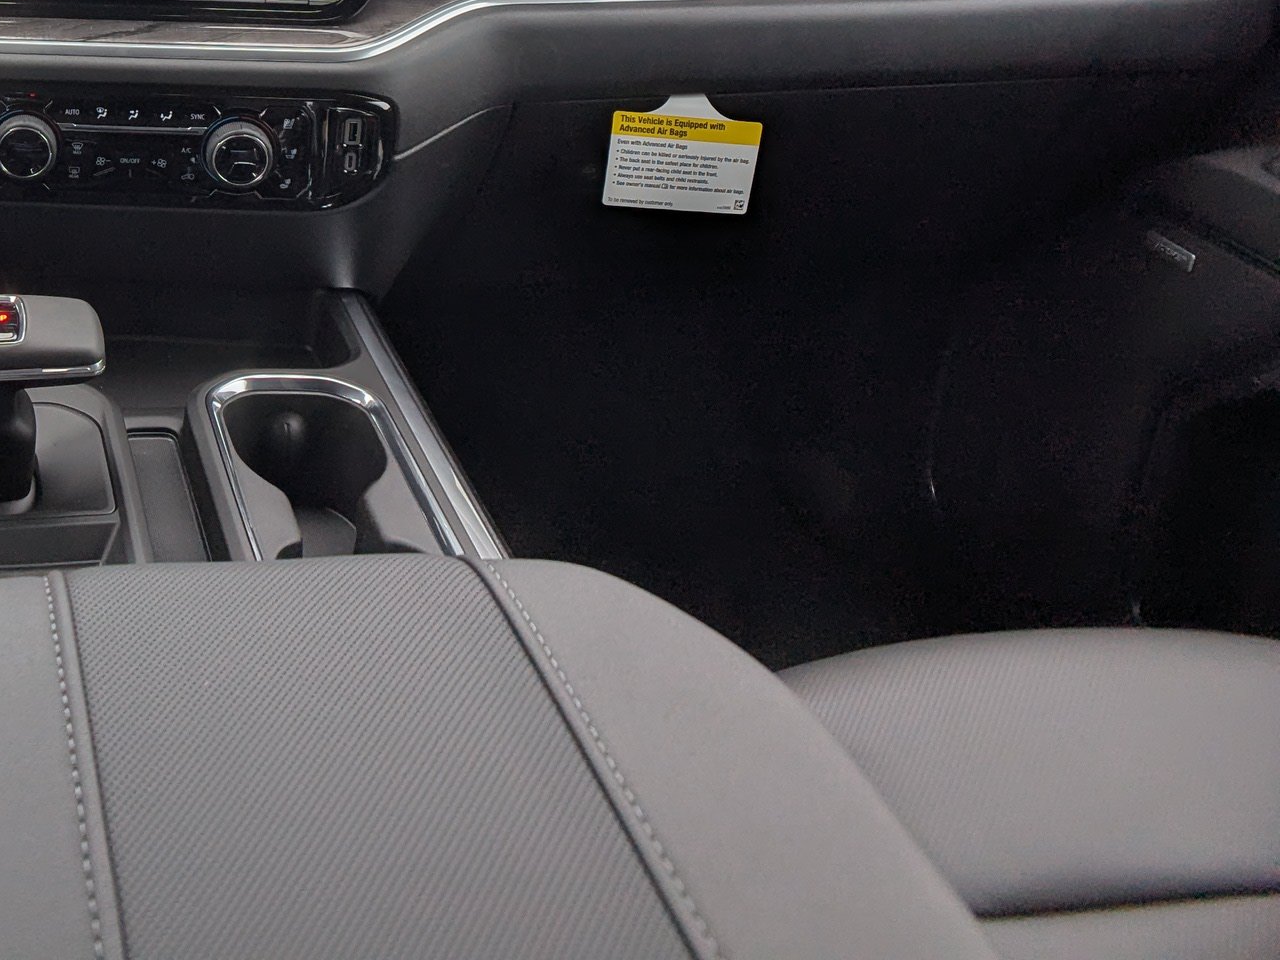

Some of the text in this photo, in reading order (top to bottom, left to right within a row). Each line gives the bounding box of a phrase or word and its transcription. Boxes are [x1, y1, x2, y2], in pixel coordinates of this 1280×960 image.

[621, 115, 726, 131] This Vehicle is Equipped with
[620, 124, 655, 134] Advanced
[670, 128, 688, 138] Bags
[0, 314, 8, 322] P
